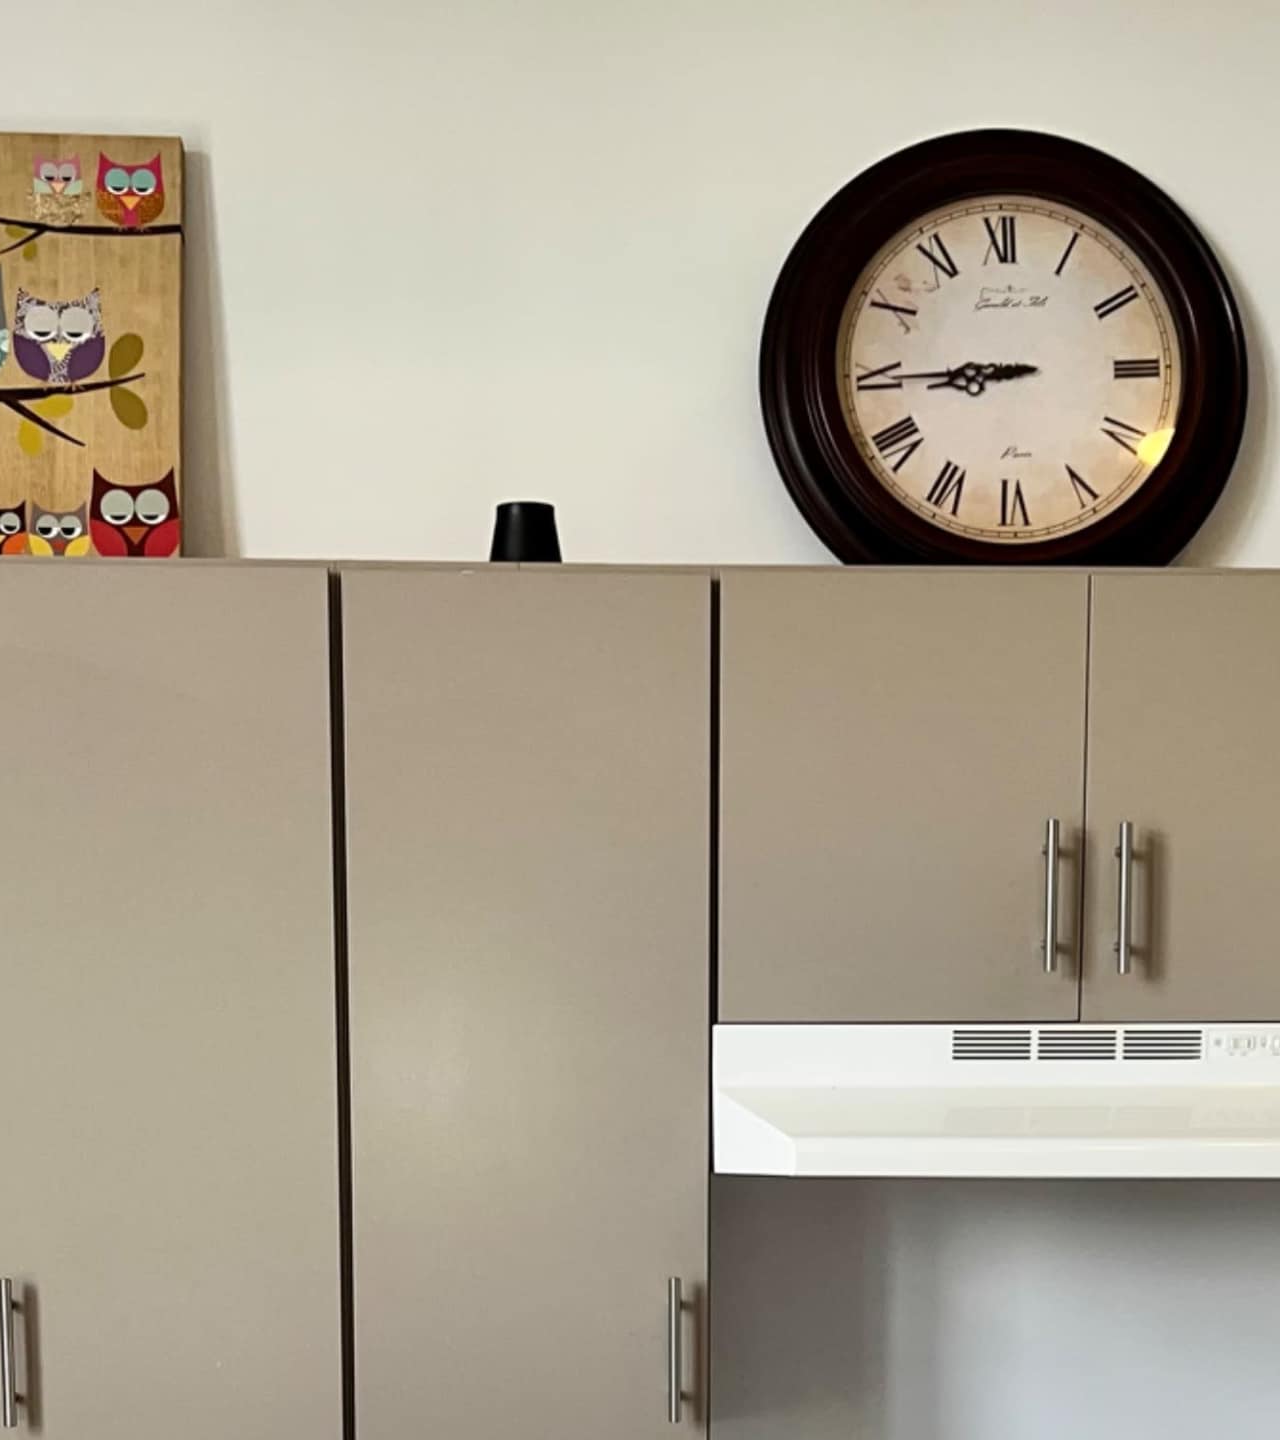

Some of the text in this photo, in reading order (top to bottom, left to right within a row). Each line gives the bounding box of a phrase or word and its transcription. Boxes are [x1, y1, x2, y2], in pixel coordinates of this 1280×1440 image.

[916, 233, 959, 288] XI
[983, 216, 1018, 264] XII
[1054, 232, 1079, 276] I
[1094, 285, 1138, 320] II
[856, 361, 903, 391] IX
[1113, 359, 1161, 379] III
[871, 416, 924, 473] VIII
[1100, 416, 1146, 456] IV
[926, 461, 966, 516] VII
[1000, 479, 1031, 527] VI
[1065, 464, 1099, 509] V
